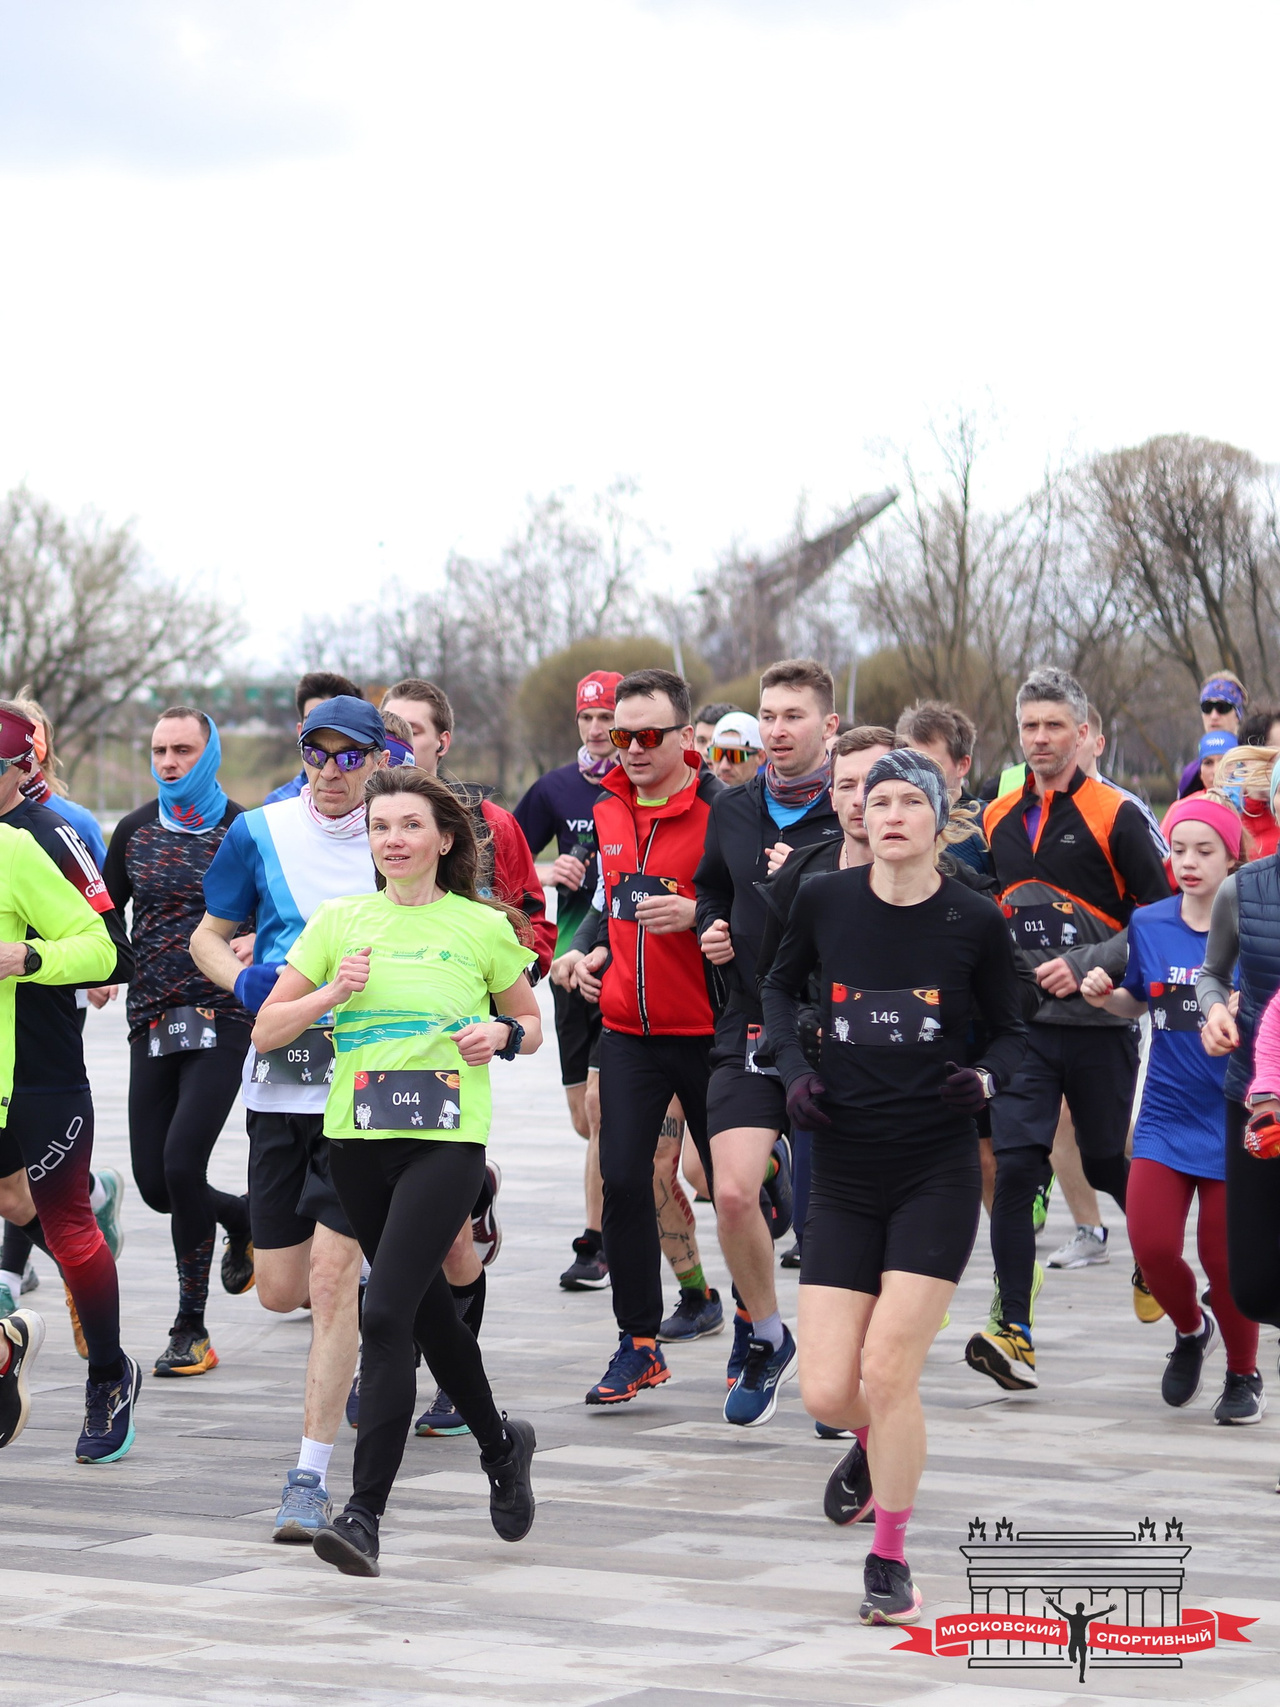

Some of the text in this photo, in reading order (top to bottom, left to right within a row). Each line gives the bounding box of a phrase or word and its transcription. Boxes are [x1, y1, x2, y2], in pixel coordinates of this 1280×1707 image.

[1024, 920, 1045, 932] 011
[1167, 966, 1187, 985] ЗА
[1182, 1000, 1202, 1012] 09
[870, 1011, 899, 1024] 146
[168, 1022, 187, 1035] 039
[287, 1049, 310, 1063] 053
[392, 1092, 420, 1106] 044
